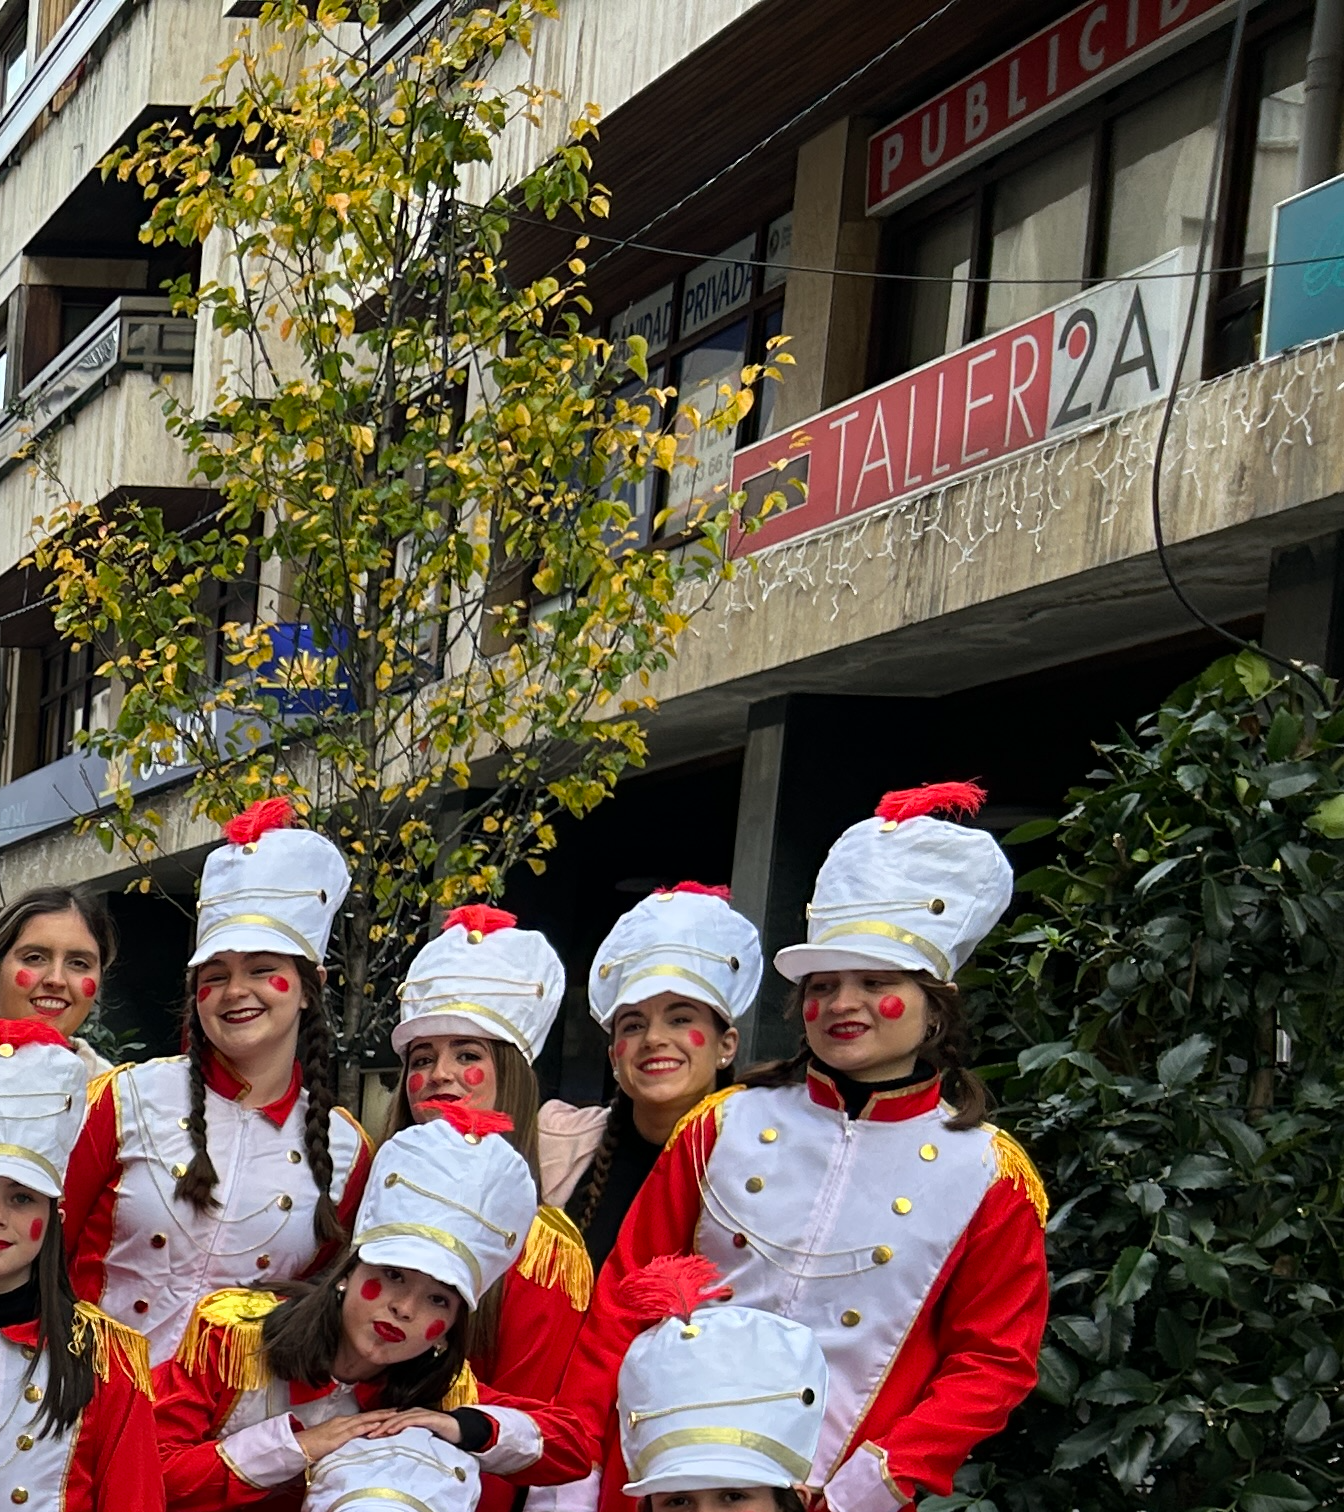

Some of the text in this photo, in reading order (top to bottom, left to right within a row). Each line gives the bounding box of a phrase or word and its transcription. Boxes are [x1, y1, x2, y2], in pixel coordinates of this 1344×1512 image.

[683, 253, 753, 332] PRIVADA
[829, 284, 1160, 515] TALLER 2A
